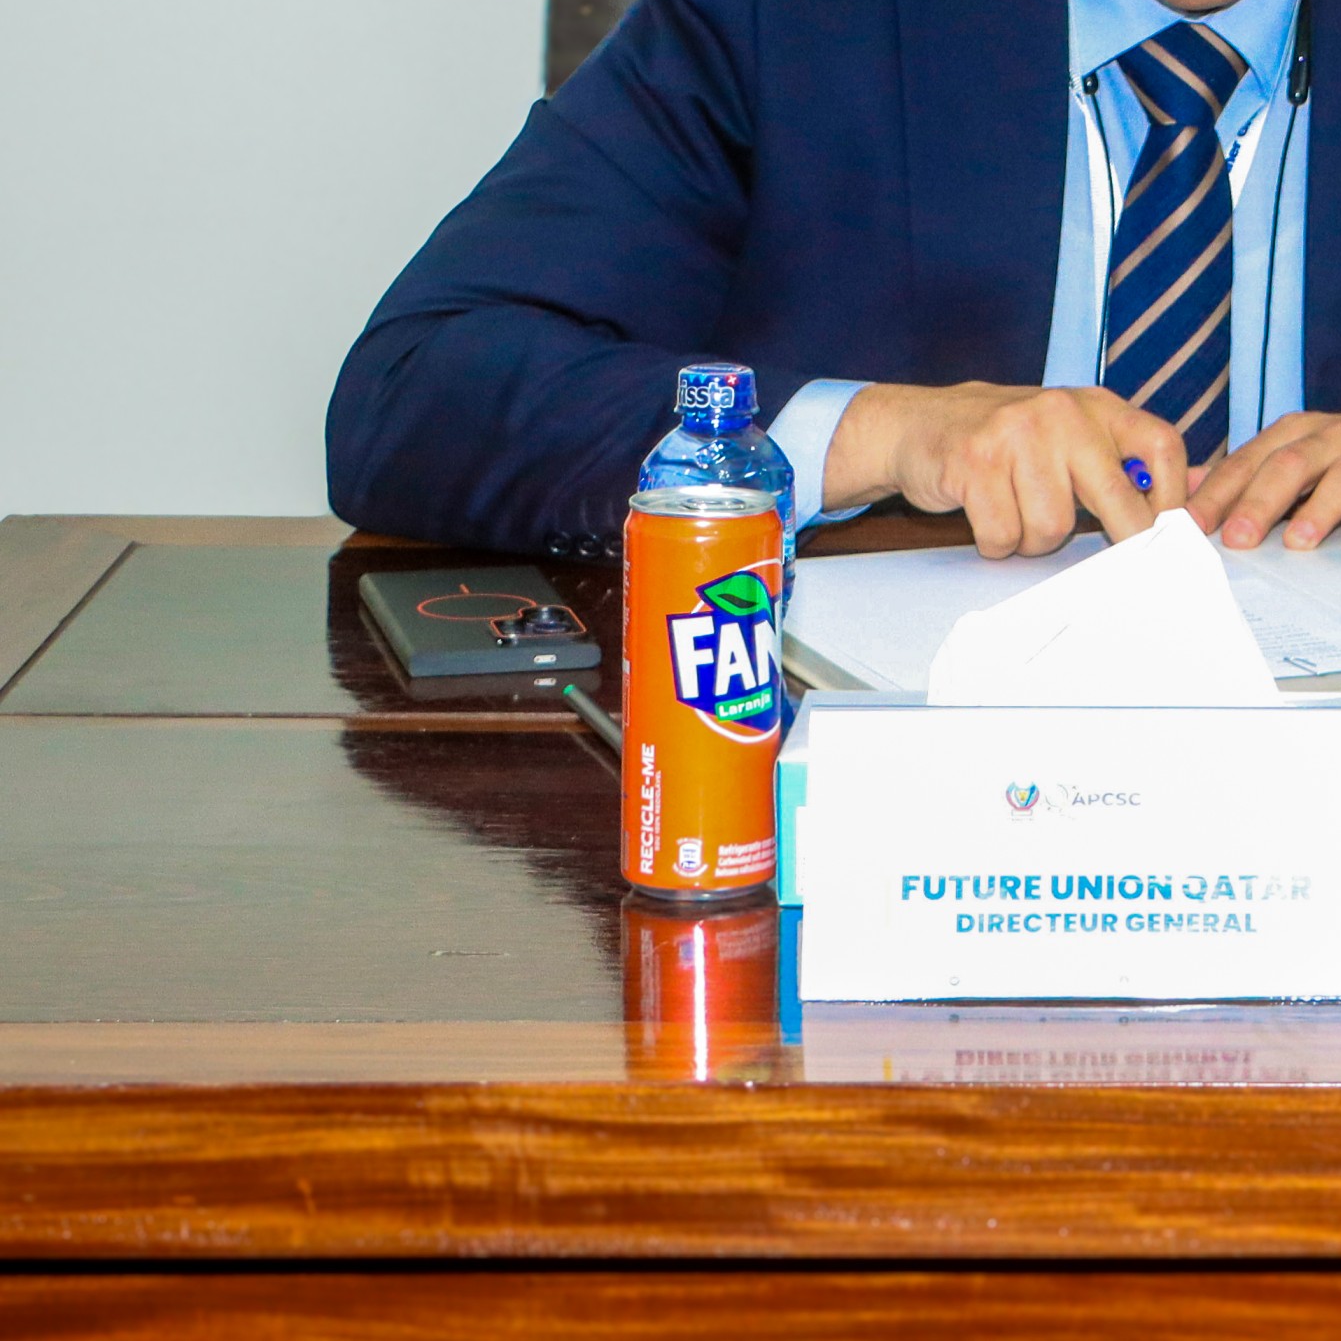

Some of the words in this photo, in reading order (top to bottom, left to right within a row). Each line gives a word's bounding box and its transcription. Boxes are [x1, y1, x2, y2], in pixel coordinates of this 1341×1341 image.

[718, 692, 771, 718] Laranja
[639, 743, 655, 875] RECICLE-ME
[1072, 792, 1142, 807] APCSC
[901, 875, 1042, 901] FUTURE
[1051, 875, 1173, 901] UNION
[1182, 875, 1312, 904] QATAR
[956, 913, 1118, 934] DIRECTEUR
[1125, 913, 1258, 933] GENERAL
